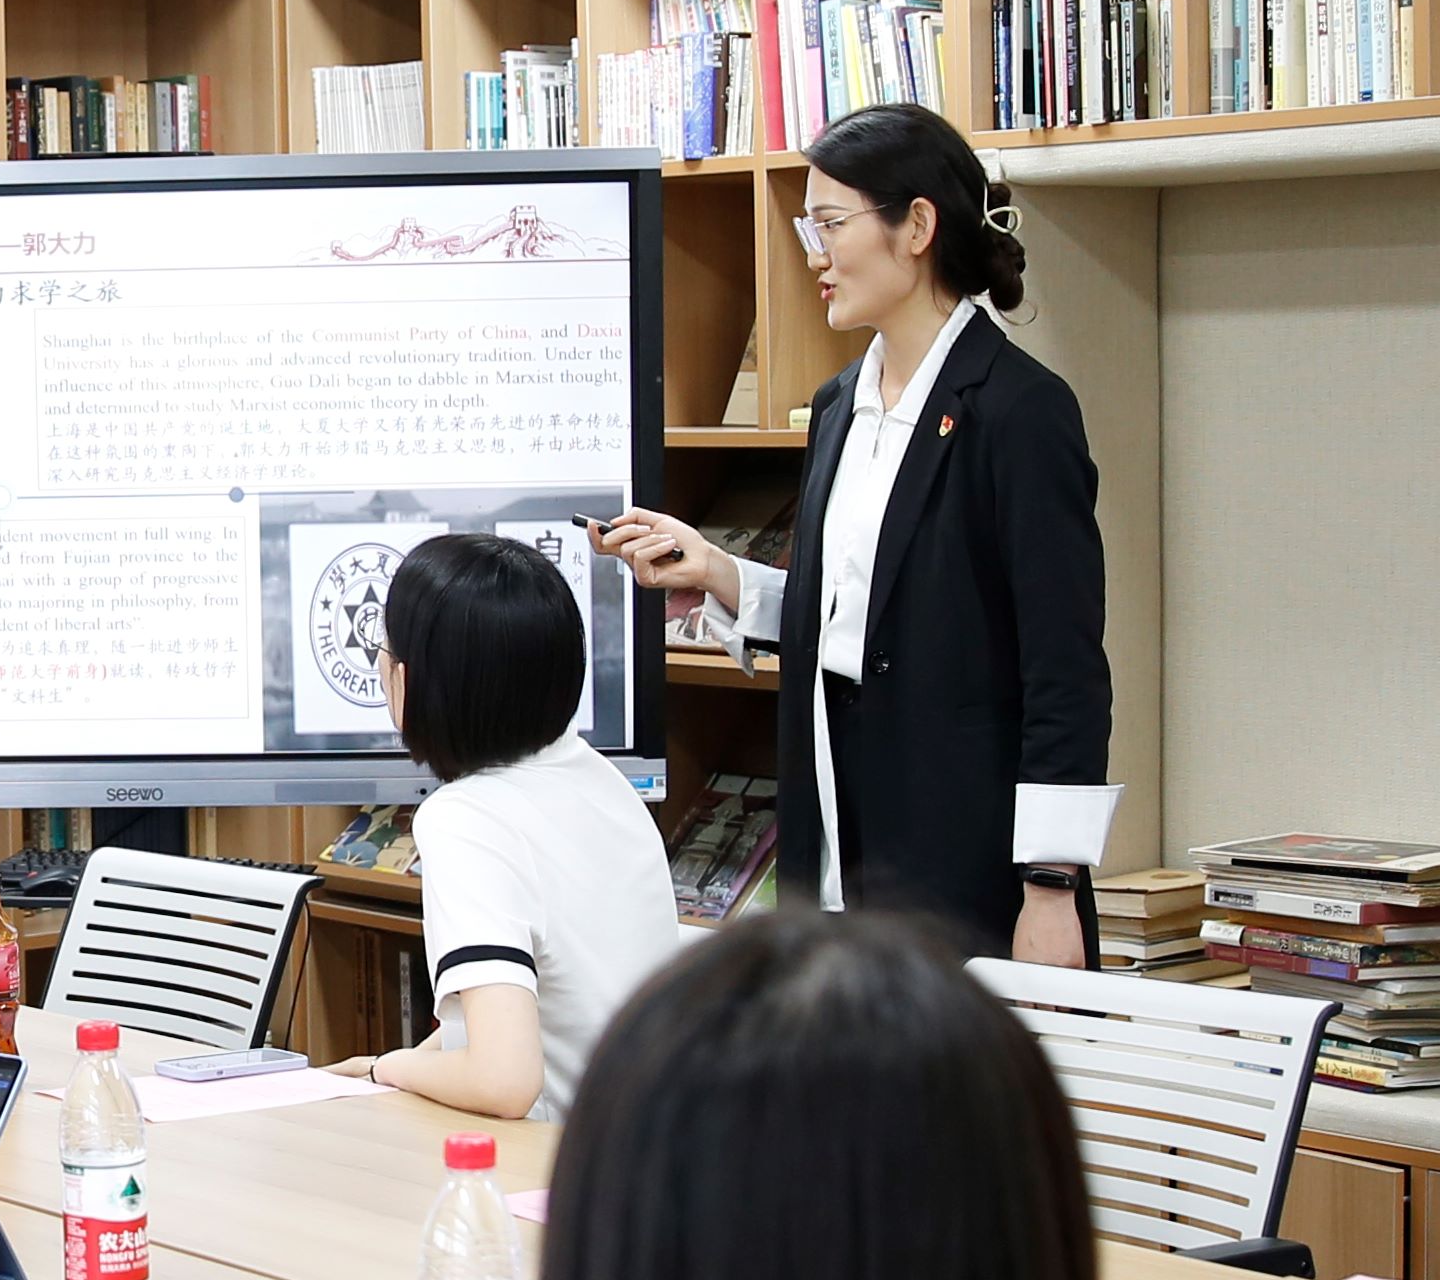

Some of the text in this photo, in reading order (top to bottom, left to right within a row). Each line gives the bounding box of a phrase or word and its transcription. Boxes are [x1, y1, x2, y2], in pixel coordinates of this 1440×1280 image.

[44, 366, 624, 394] influence of this atmosphere, Guo Dali began to dabble in Marxist thought,
[39, 528, 118, 543] movement
[123, 526, 138, 543] in
[144, 525, 169, 544] full
[175, 528, 212, 544] wing.
[223, 524, 238, 541] In
[19, 549, 55, 569] from
[63, 548, 111, 568] Fujian
[119, 551, 184, 568] province
[192, 550, 208, 563] to
[215, 546, 238, 562] the
[22, 571, 56, 587] with
[63, 575, 72, 587] a
[79, 574, 122, 591] group
[129, 570, 146, 586] of
[152, 572, 239, 589] progressive
[18, 596, 85, 613] majoring
[91, 592, 105, 609] in
[110, 591, 197, 612] philosophy,
[203, 590, 239, 607] from
